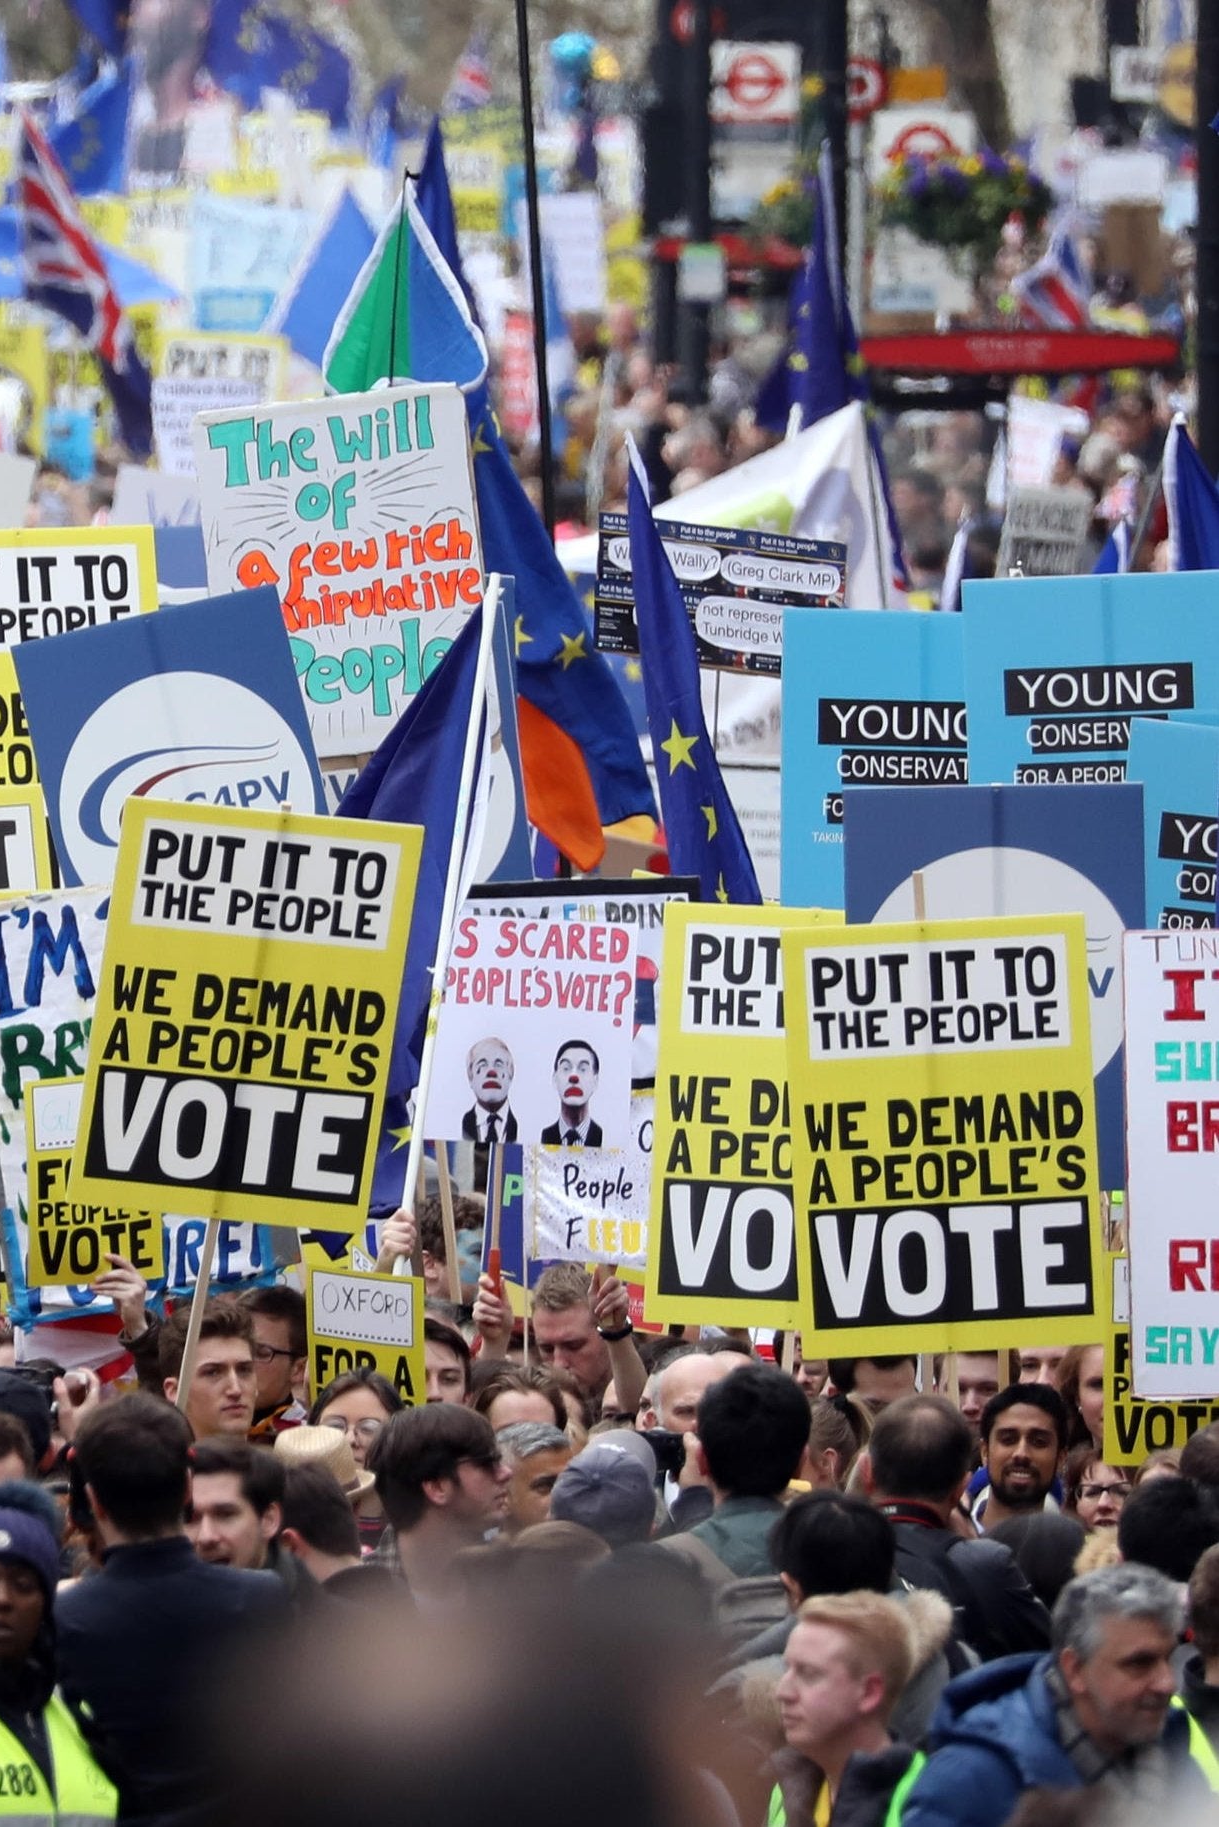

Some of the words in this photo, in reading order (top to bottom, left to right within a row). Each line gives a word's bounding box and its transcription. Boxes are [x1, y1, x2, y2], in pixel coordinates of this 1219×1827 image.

[208, 416, 319, 489] The
[295, 471, 357, 530] of
[237, 549, 281, 591] a
[288, 534, 379, 604] few
[386, 517, 473, 571] rich
[673, 550, 719, 572] Wally?
[715, 530, 737, 541] people
[796, 542, 818, 552] people
[16, 556, 57, 604] IT
[73, 554, 128, 602] TO
[727, 560, 765, 582] (Greg
[768, 566, 805, 584] Clark
[808, 572, 837, 590] MP)
[702, 604, 725, 617] not
[703, 621, 769, 645] Tunbridge
[1017, 668, 1179, 709] YOUNG
[1054, 768, 1068, 784] A
[144, 827, 246, 884] PUT
[259, 839, 311, 892] IT
[328, 846, 388, 900] TO
[140, 879, 215, 924] THE
[225, 890, 381, 941] PEOPLE
[495, 922, 631, 965] SCARED
[688, 932, 782, 986] PUT
[113, 963, 178, 1016] WE
[191, 973, 387, 1038] DEMAND
[555, 971, 633, 1029] VOTE?
[810, 953, 909, 1008] PUT
[929, 948, 976, 1001] IT
[993, 945, 1057, 997] TO
[687, 986, 762, 1028] THE
[812, 1009, 890, 1051] THE
[903, 1000, 1060, 1046] PEOPLE
[101, 1016, 130, 1063] A
[146, 1022, 381, 1087] PEOPLE'S
[668, 1074, 732, 1126] WE
[803, 1100, 868, 1153] WE
[886, 1090, 1085, 1149] DEMAND
[102, 1070, 368, 1196] VOTE
[665, 1127, 692, 1175] A
[563, 1163, 634, 1209] People
[808, 1156, 838, 1205] A
[852, 1145, 1087, 1203] PEOPLE'S
[38, 1219, 153, 1277] VOTE
[813, 1200, 1088, 1320] VOTE
[322, 1282, 409, 1323] OXFORD
[392, 1355, 415, 1397] A
